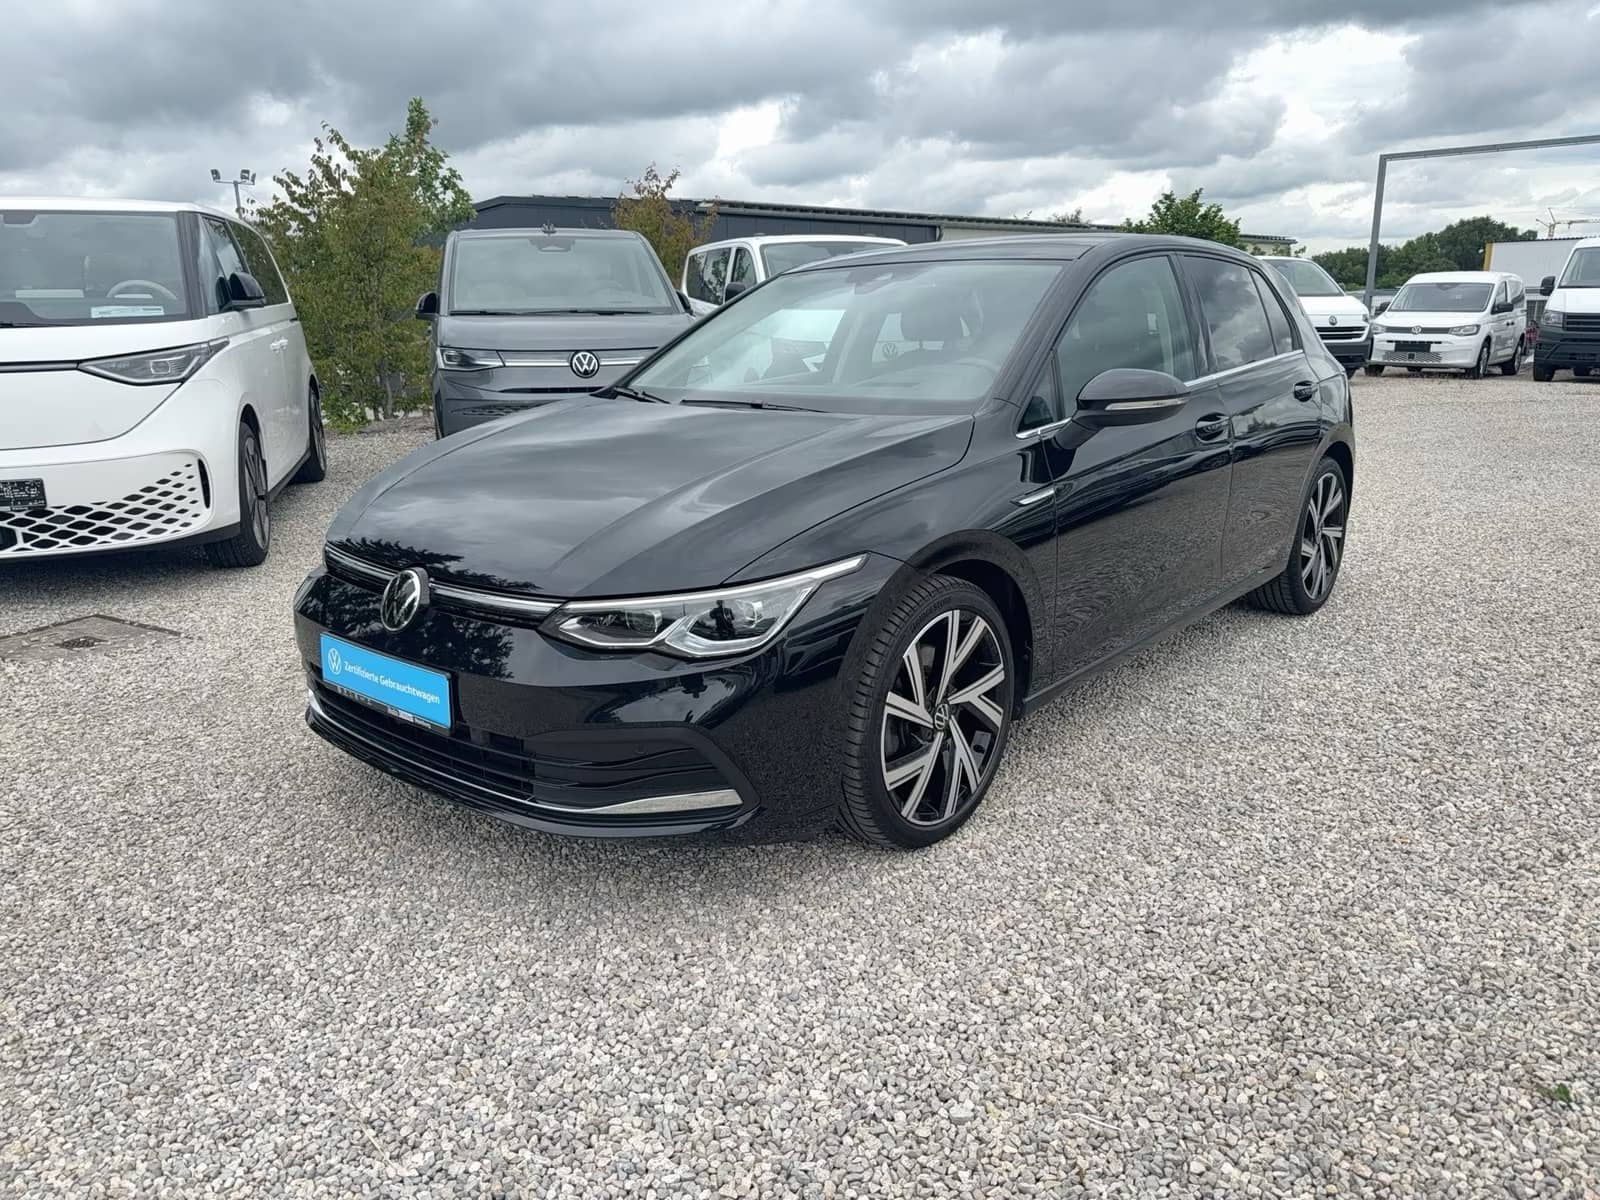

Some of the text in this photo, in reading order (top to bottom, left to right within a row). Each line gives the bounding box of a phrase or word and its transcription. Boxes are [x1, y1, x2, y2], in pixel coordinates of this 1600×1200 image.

[572, 351, 598, 378] VW
[328, 648, 342, 675] VW
[344, 661, 378, 684] Zertifizierte
[379, 675, 440, 704] Gebrauchtwagen
